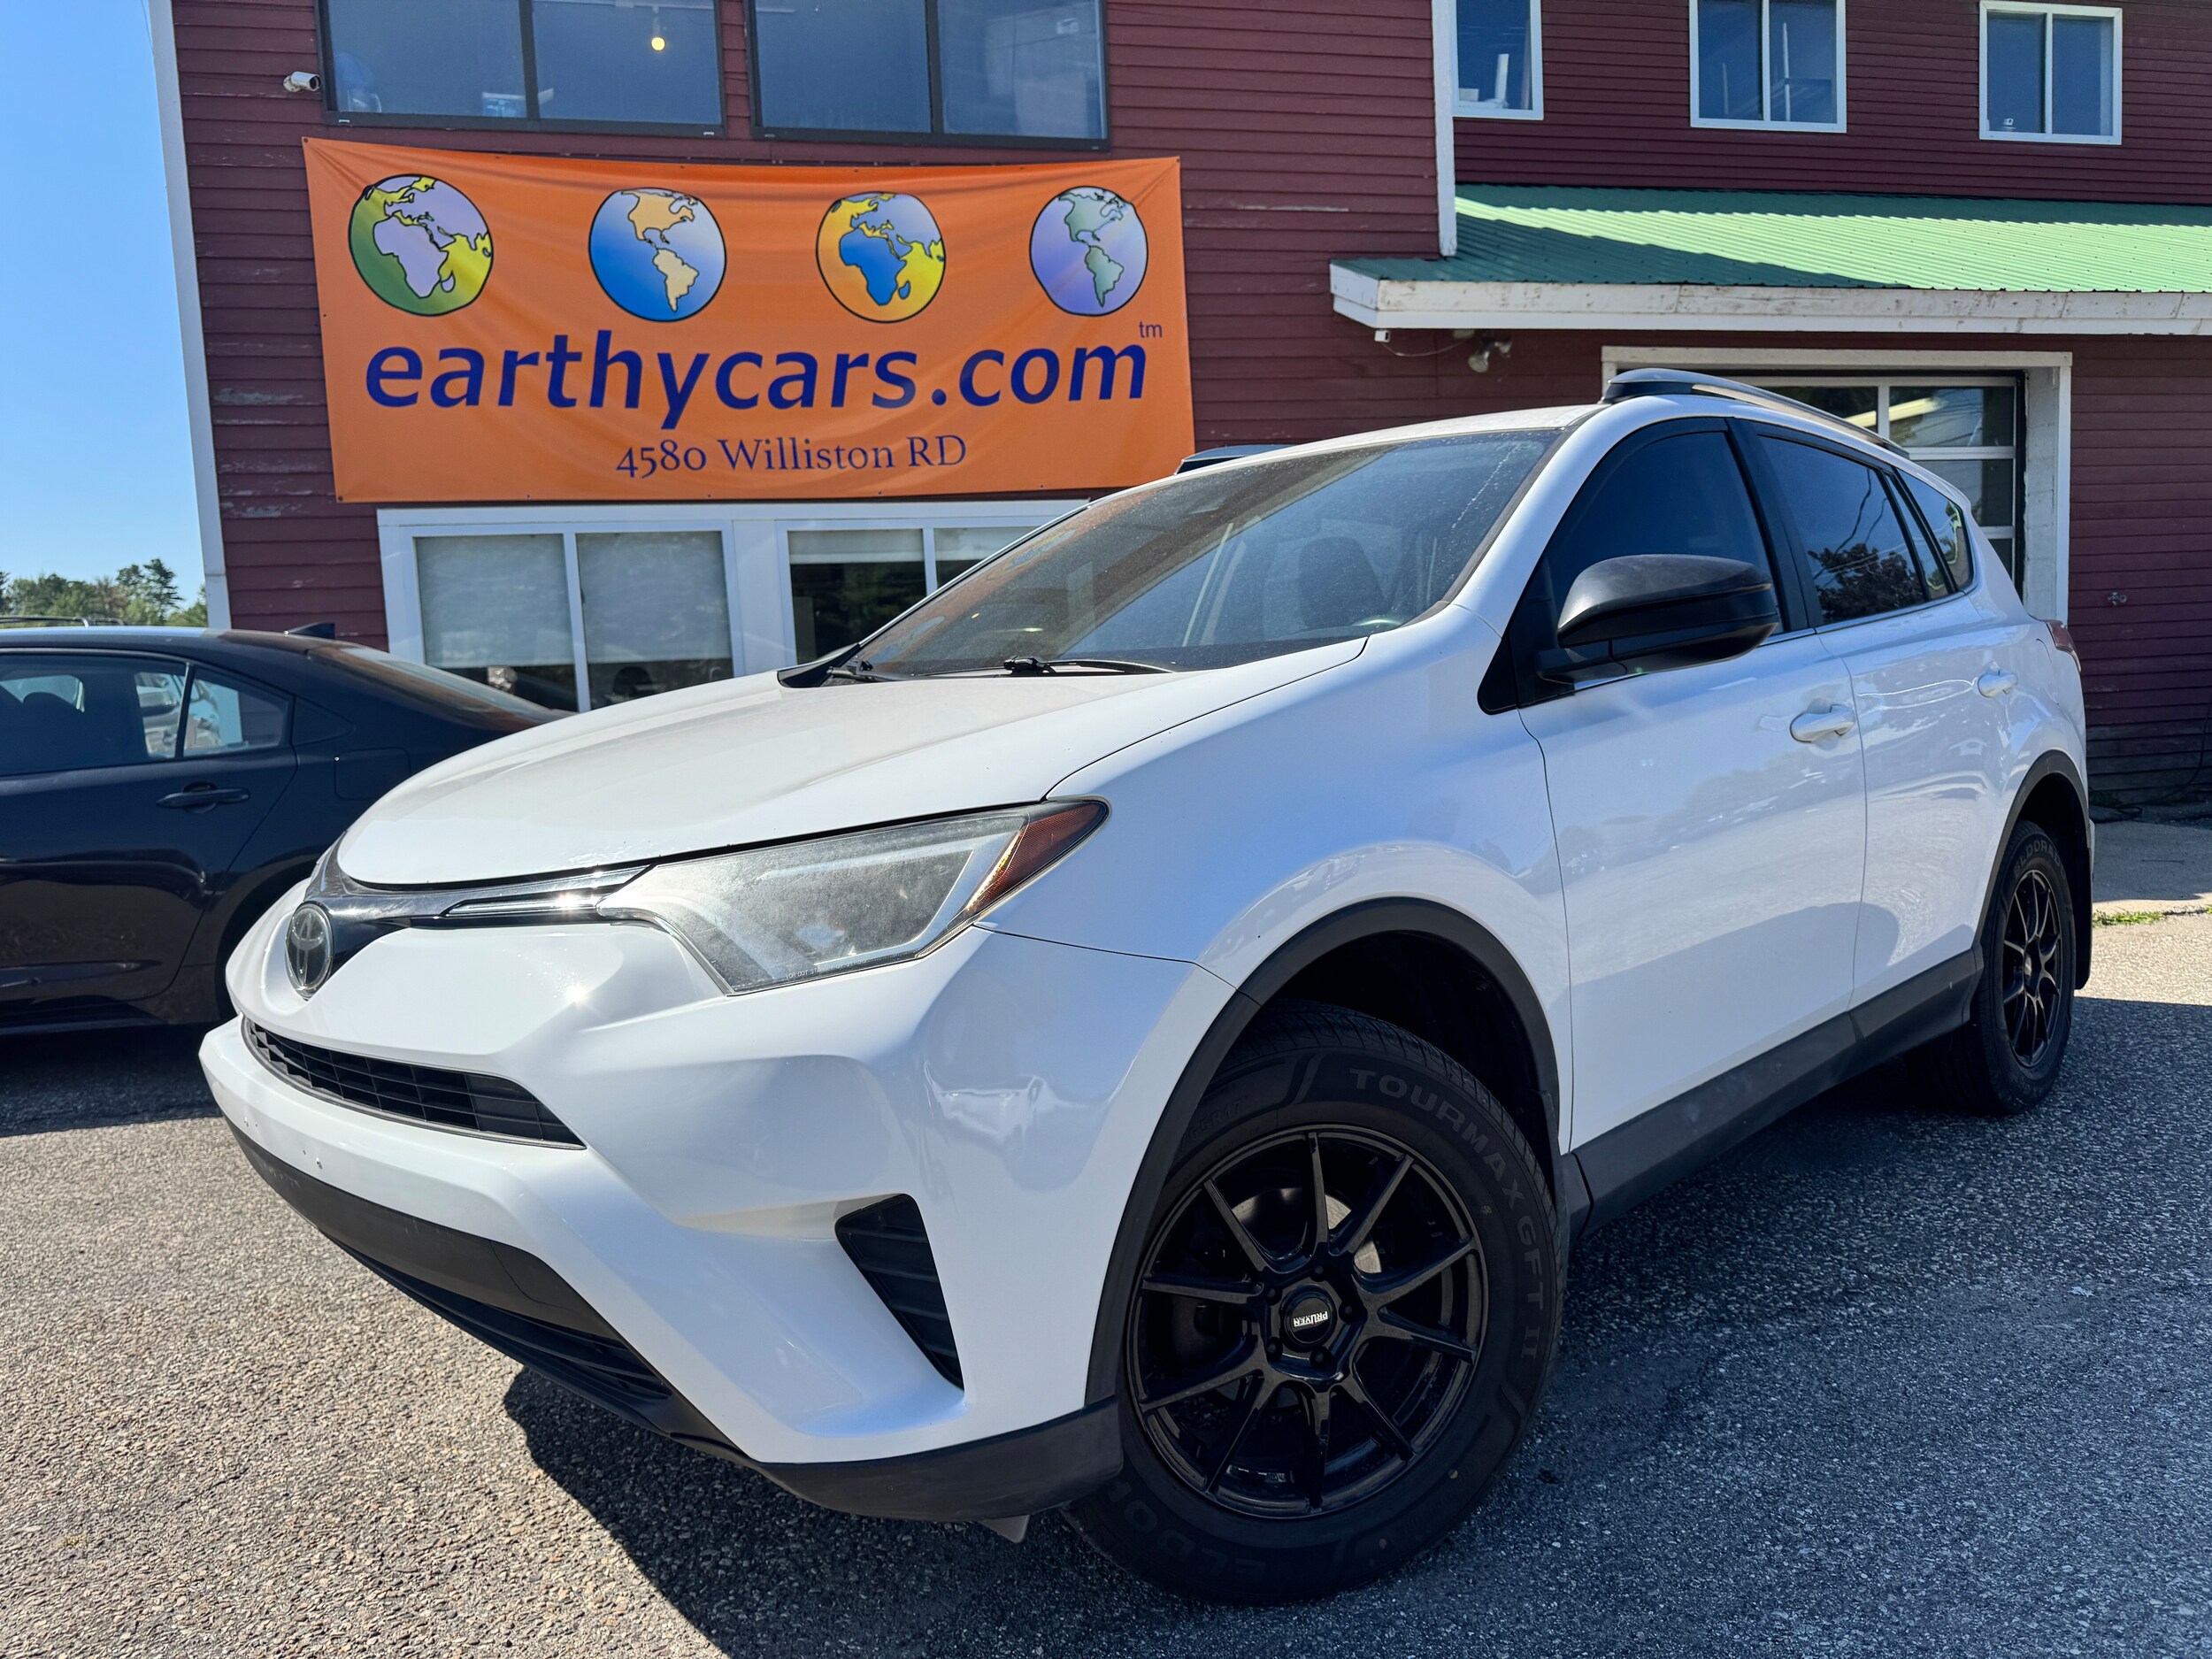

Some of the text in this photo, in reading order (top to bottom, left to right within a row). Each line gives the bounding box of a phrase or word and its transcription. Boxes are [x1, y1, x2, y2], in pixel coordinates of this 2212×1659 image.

[365, 320, 1163, 431] earthycars.com tm
[616, 434, 966, 479] 4580 Williston RD
[2013, 839, 2067, 880] ELDORADO
[1348, 1067, 1525, 1212] TOURMAX
[1516, 1215, 1544, 1311] GFT
